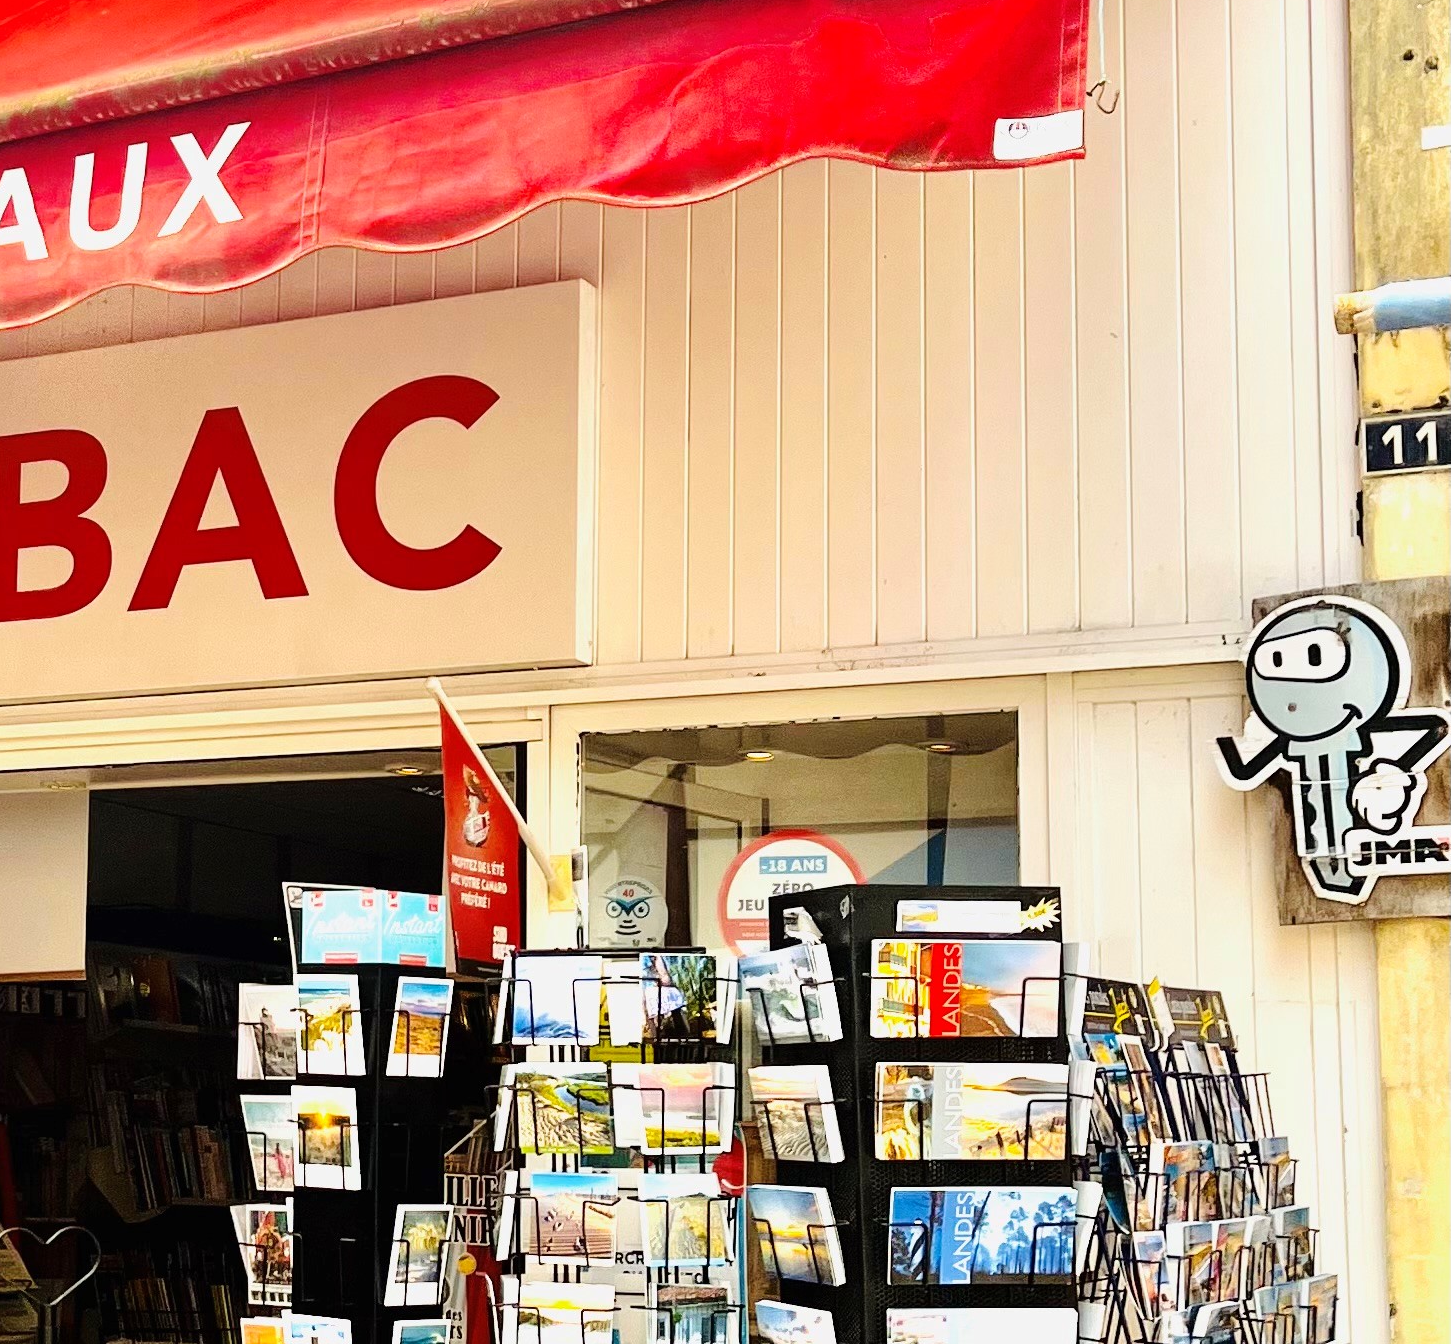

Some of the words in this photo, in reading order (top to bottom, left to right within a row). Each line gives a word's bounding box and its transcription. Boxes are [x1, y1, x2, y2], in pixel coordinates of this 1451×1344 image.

[1381, 420, 1439, 466] 11
[789, 858, 825, 872] ANS
[622, 888, 635, 898] 40
[737, 899, 765, 912] JEU
[941, 943, 963, 1038] LANDES
[941, 1065, 965, 1159] LANDES
[951, 1191, 976, 1285] LANDES
